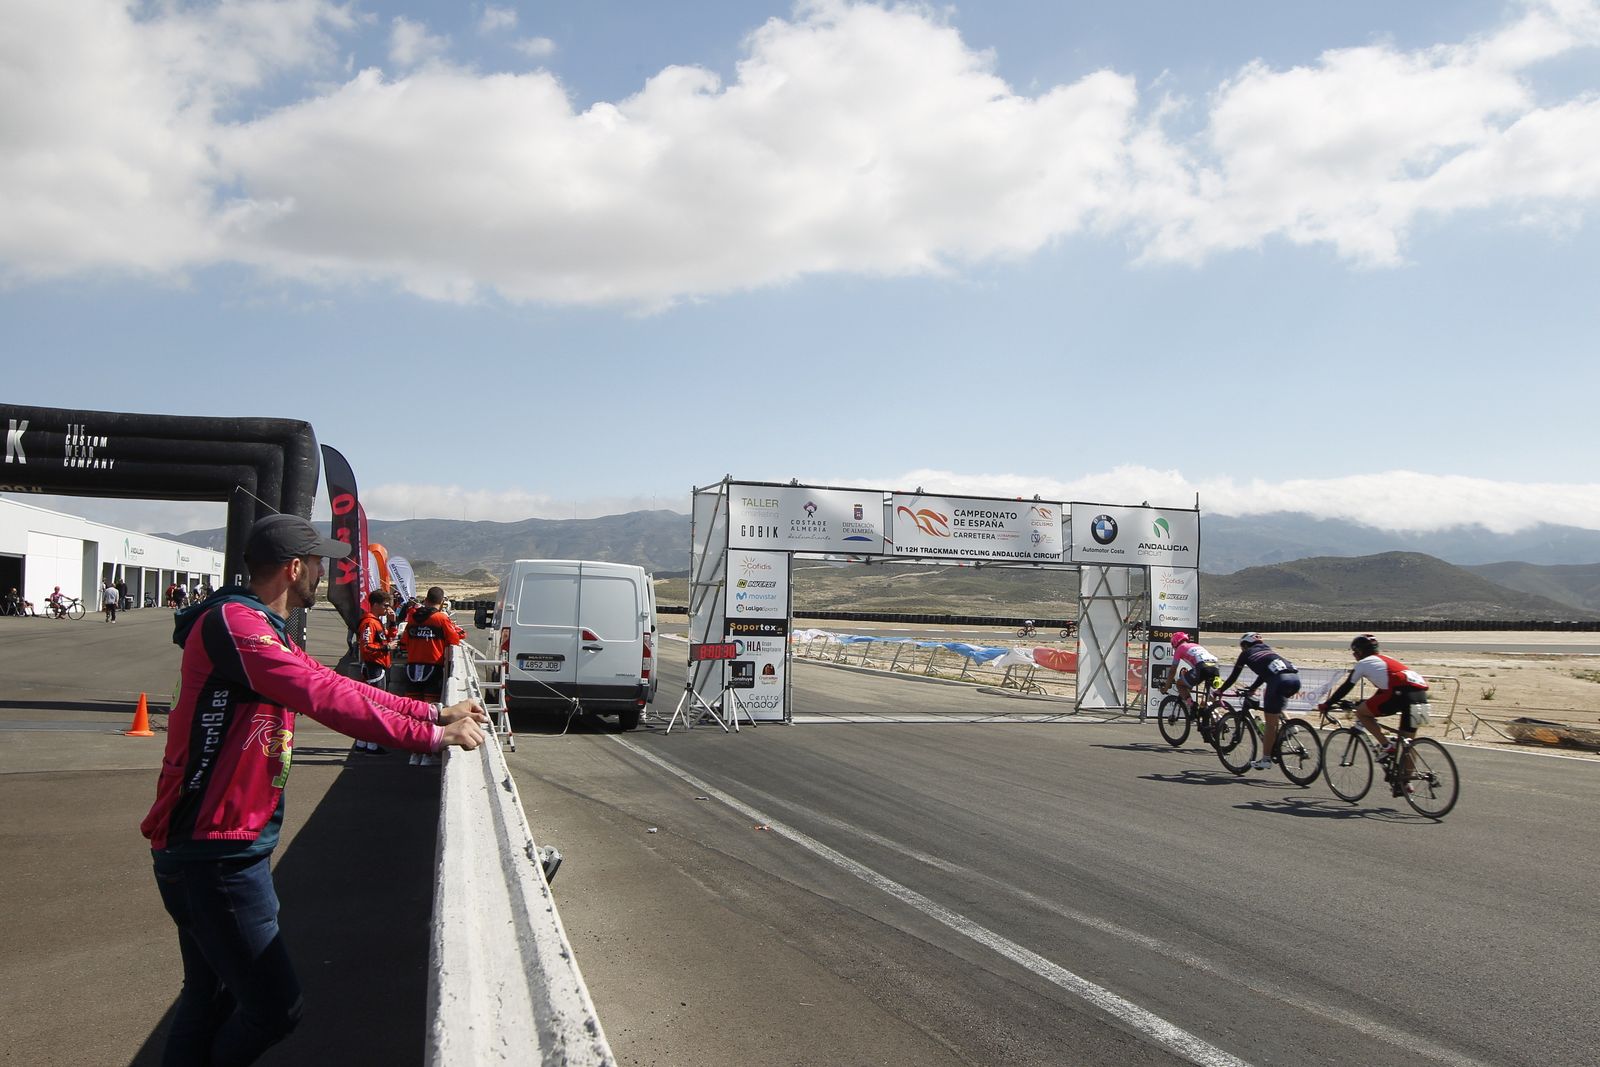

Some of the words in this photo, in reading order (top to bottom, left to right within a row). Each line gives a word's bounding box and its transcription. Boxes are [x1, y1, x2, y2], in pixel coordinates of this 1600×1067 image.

[67, 424, 85, 435] THE
[65, 434, 108, 447] CUSTOM
[64, 445, 94, 457] WEAR
[63, 458, 115, 469] COMPANY
[741, 498, 779, 508] TALLER
[953, 509, 1018, 520] CAMPEONATO
[953, 519, 966, 527] DE
[968, 519, 1005, 529] ESPAÑA
[741, 525, 779, 538] GOBIK
[920, 547, 959, 555] TRACKMAN
[730, 622, 776, 632] Soportex
[746, 641, 761, 652] HLA
